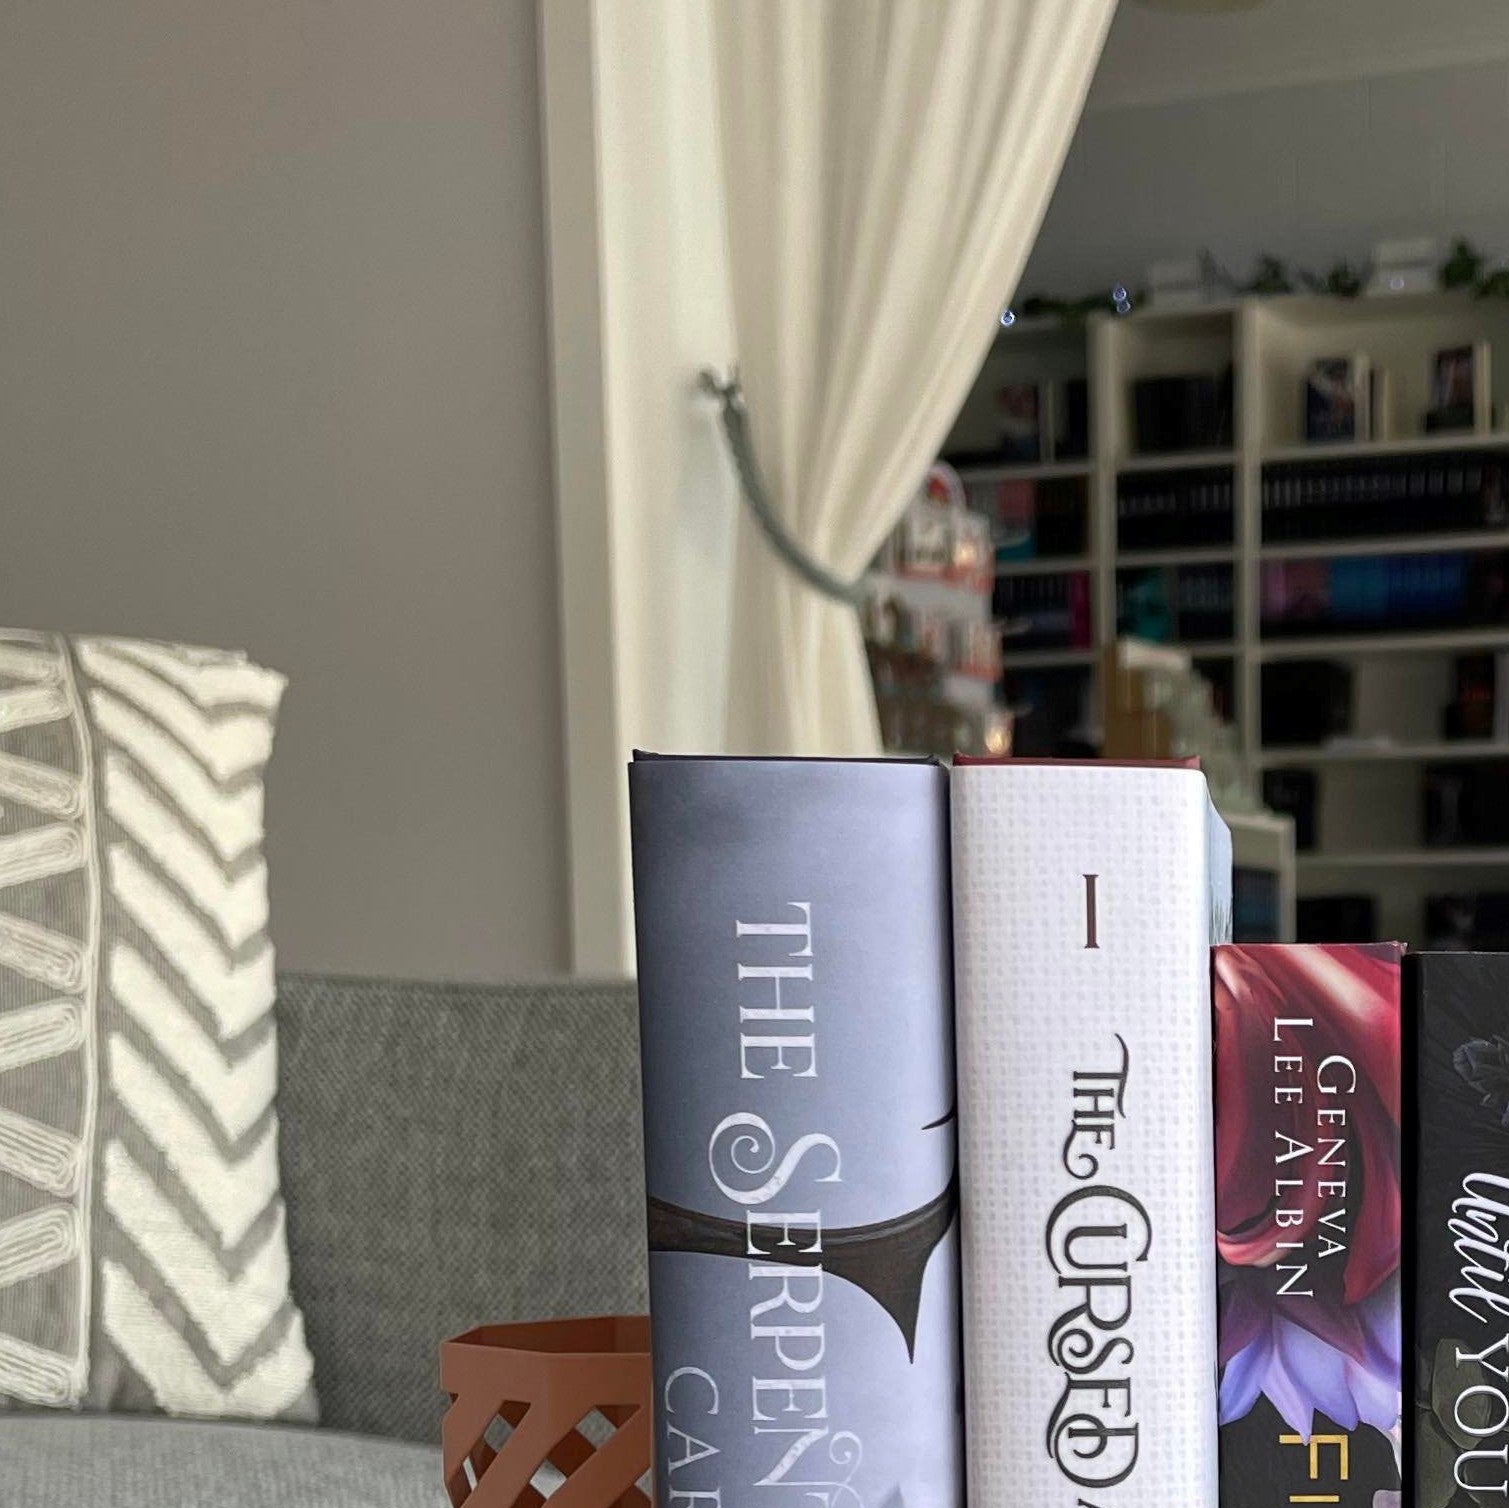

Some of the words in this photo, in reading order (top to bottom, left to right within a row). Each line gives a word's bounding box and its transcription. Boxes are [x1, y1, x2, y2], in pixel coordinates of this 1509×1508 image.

[735, 901, 818, 1079] THE
[1273, 1016, 1315, 1105] LEE
[1062, 1032, 1130, 1181] THE
[1315, 1053, 1358, 1259] GENEVA
[1274, 1130, 1316, 1298] ALBIN
[1044, 1184, 1152, 1489] CURSED
